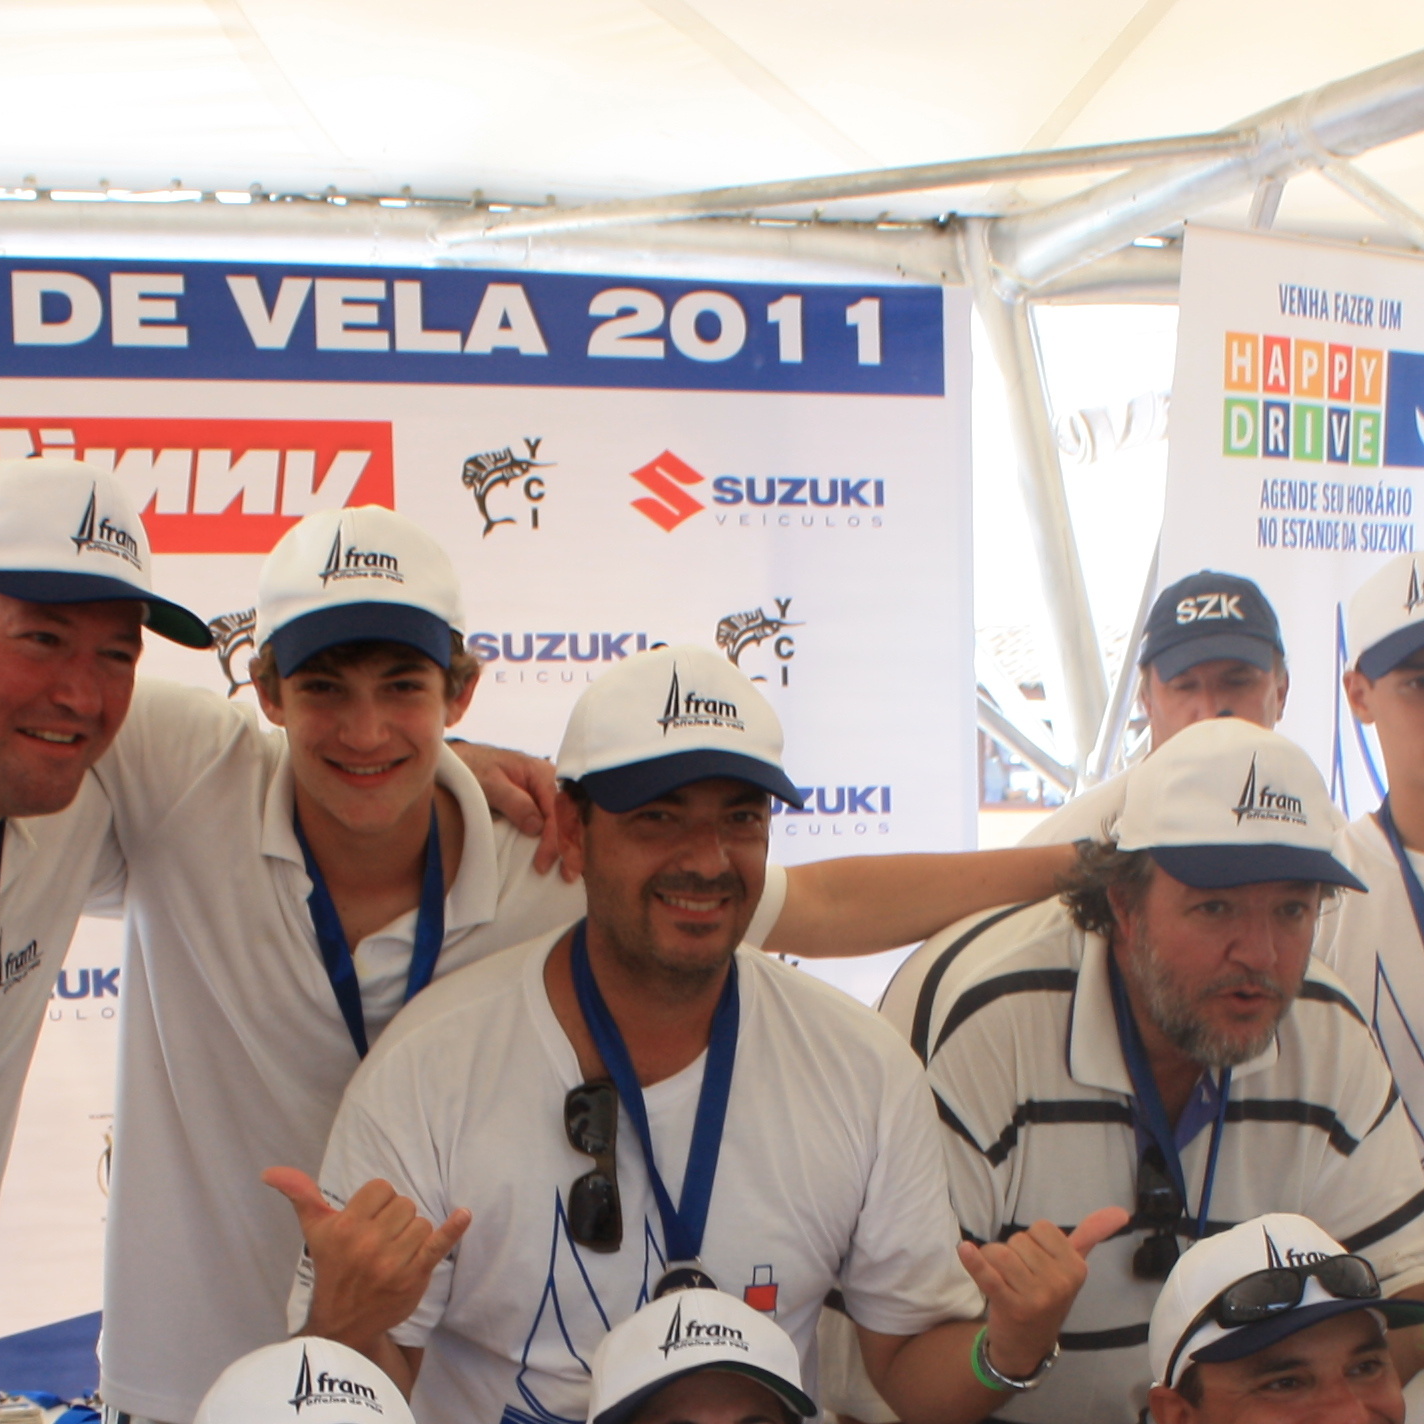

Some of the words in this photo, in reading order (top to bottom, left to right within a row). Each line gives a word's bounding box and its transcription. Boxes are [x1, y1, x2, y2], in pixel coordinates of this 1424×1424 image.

[12, 269, 190, 348] DE
[226, 275, 548, 356] VELA
[587, 288, 883, 367] 2011
[1279, 284, 1329, 321] VENHA
[1334, 292, 1374, 327] FAZER
[1379, 299, 1402, 330] UM
[1231, 340, 1377, 396] HAPPY
[1230, 405, 1373, 460] DRIVE
[712, 476, 885, 508] SUZUKI
[1260, 479, 1317, 512] AGENDE
[1323, 483, 1344, 514] SEU
[1347, 481, 1412, 517] HORÁRIO
[99, 517, 138, 557] fram
[1258, 517, 1276, 548] NO
[1282, 518, 1340, 550] ESTANDE
[1342, 522, 1357, 550] DA
[1361, 523, 1414, 553] SUZUKI
[345, 546, 398, 571] fram
[1176, 593, 1244, 625] SZK
[466, 632, 647, 664] SUZUKI
[684, 692, 737, 718] fram
[1260, 785, 1302, 814] fram
[686, 1320, 742, 1340] fram
[317, 1371, 376, 1400] fram
